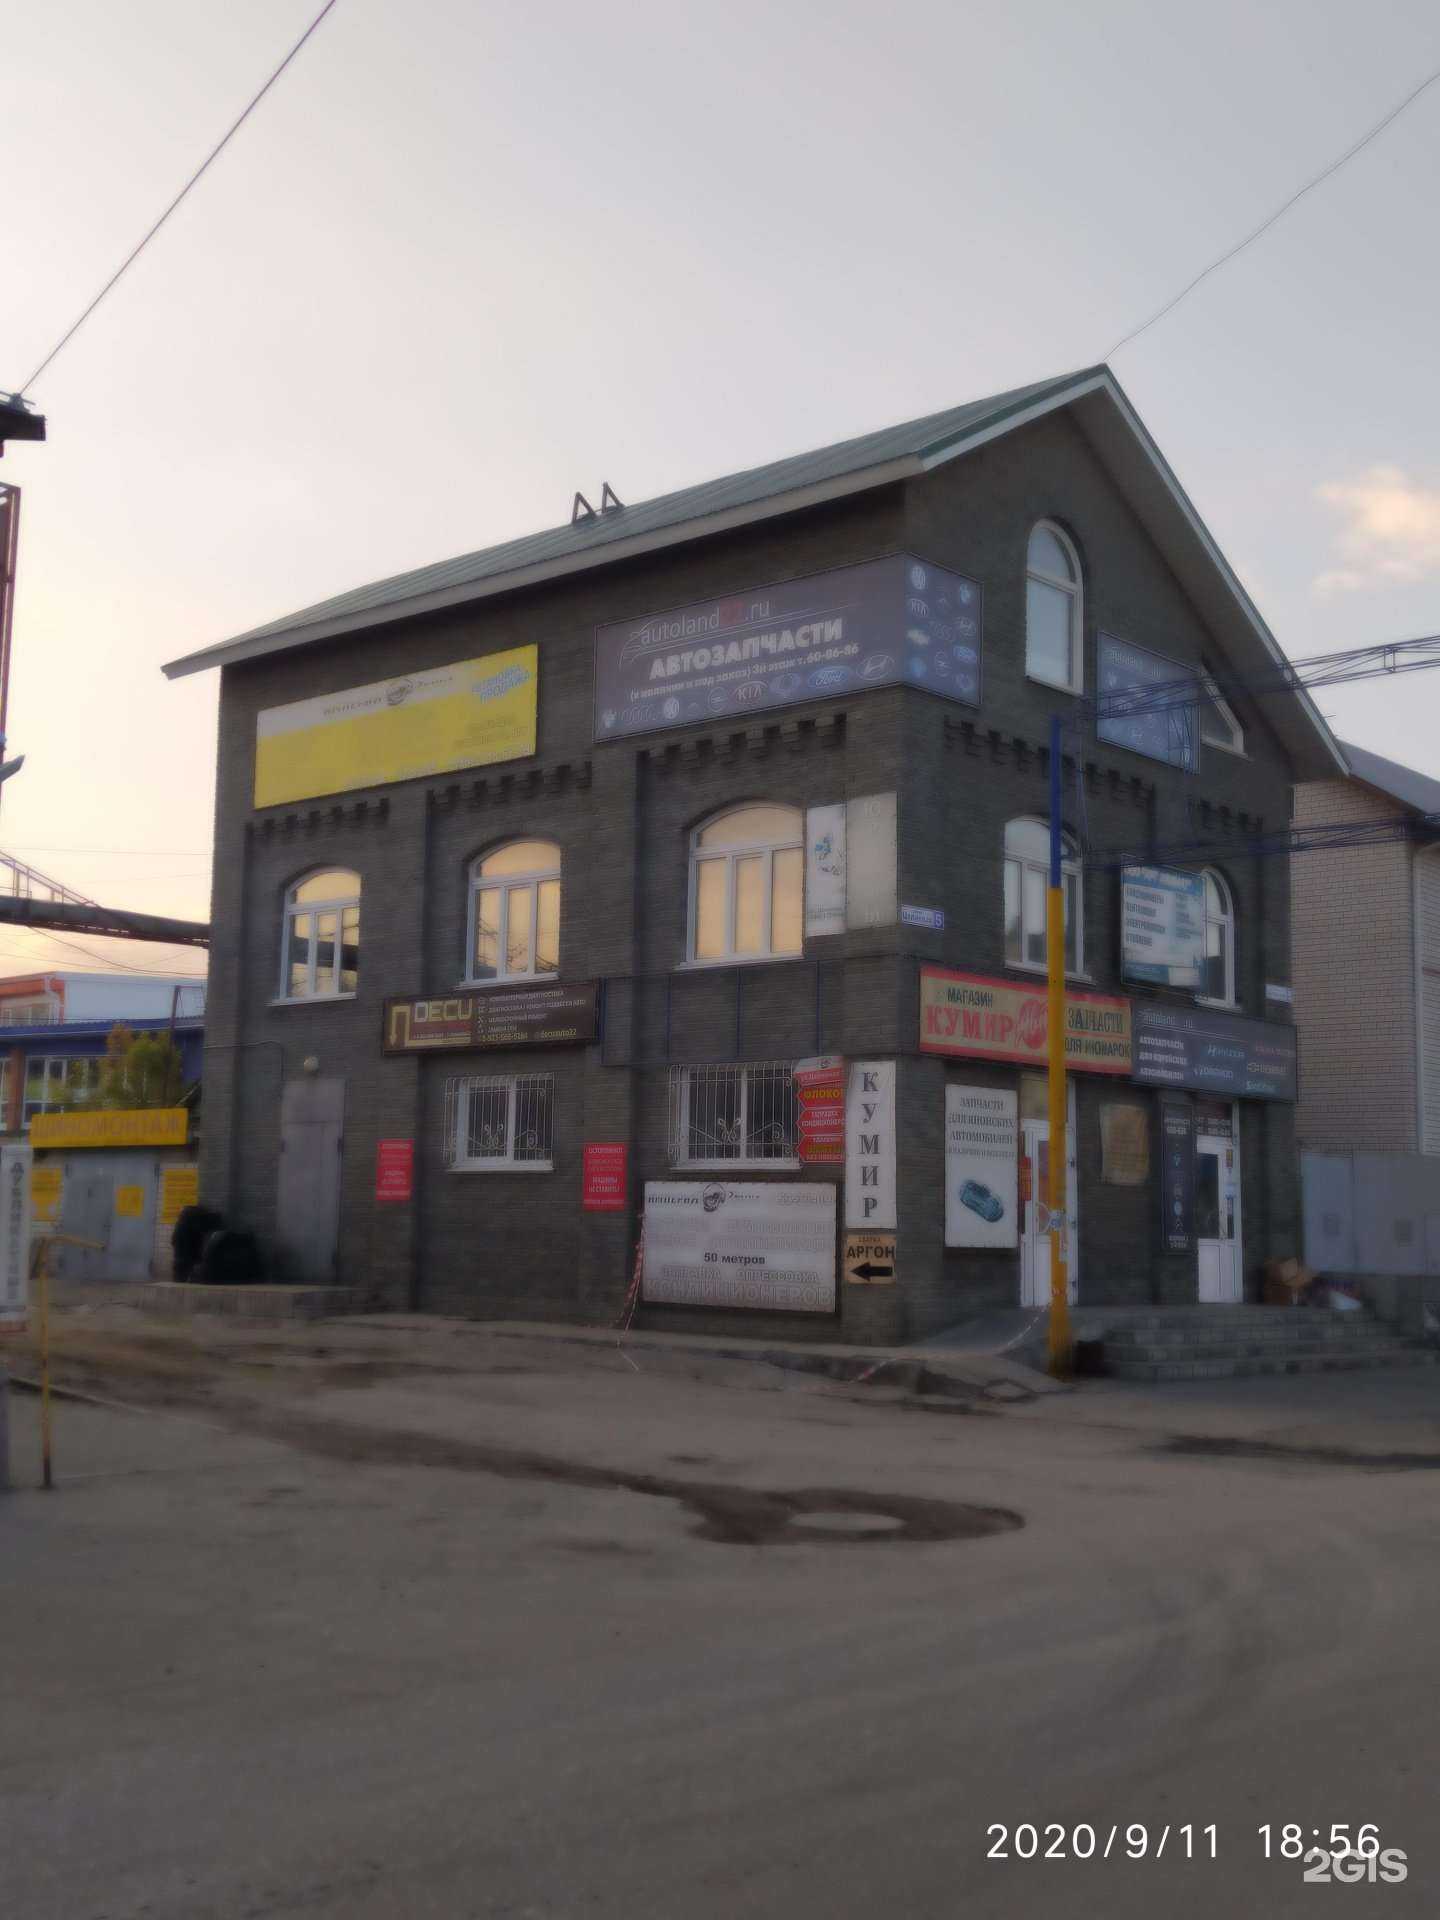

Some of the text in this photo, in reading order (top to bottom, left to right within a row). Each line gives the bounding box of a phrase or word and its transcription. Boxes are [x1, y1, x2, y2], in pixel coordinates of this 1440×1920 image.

[649, 618, 843, 680] АВТОЗАПЧАСТИ
[947, 987, 993, 1008] МАГАЗИН
[926, 1004, 1014, 1043] КУМИР
[1068, 1007, 1123, 1034] ЗАПЧАСТИ
[1085, 1040, 1130, 1058] ИНОМАРОК
[859, 1072, 880, 1218] КУМИР
[703, 1252, 766, 1266] 50 метров
[847, 1245, 896, 1260] АРГОН
